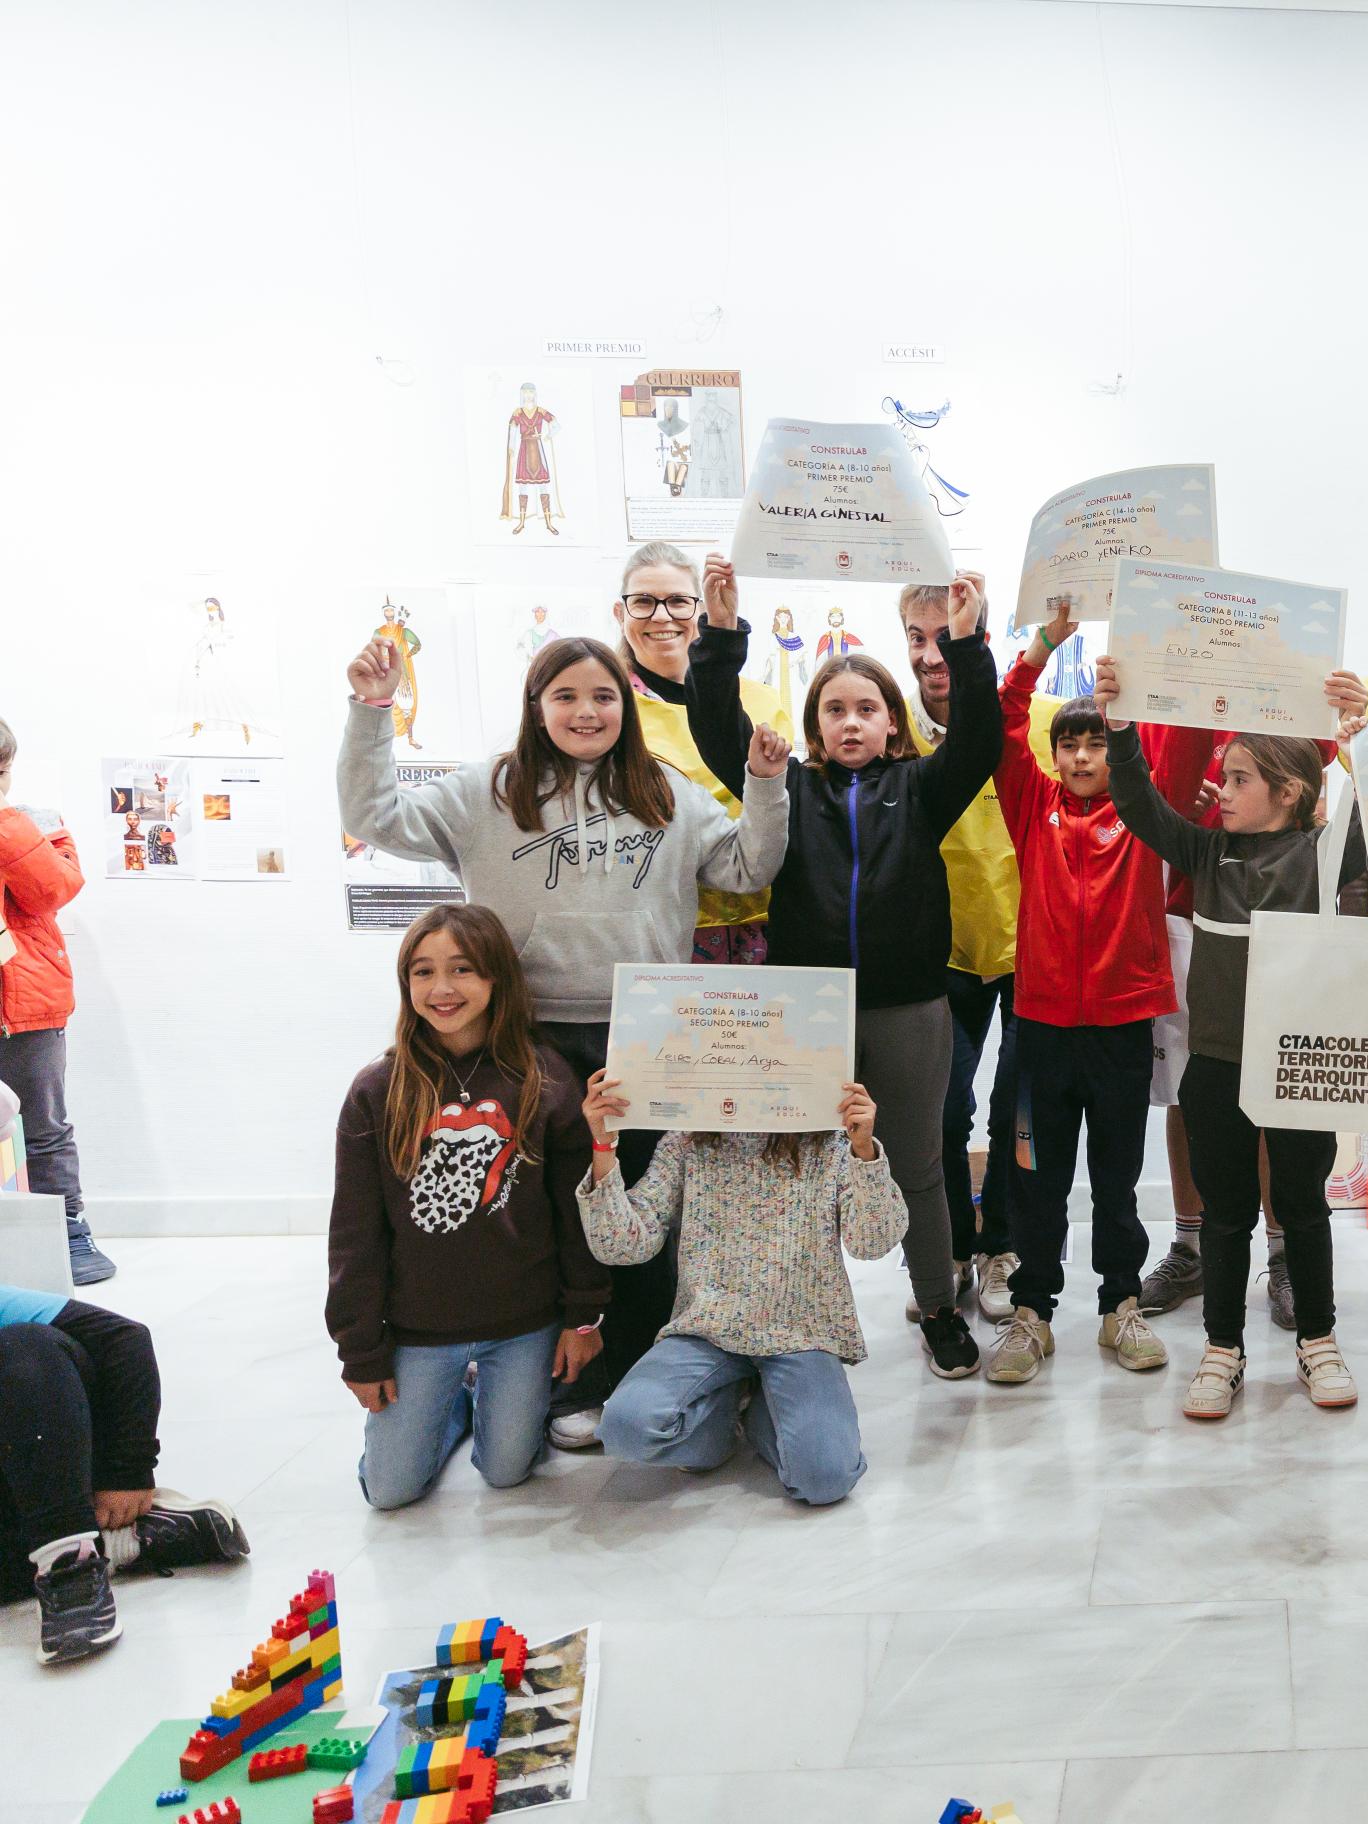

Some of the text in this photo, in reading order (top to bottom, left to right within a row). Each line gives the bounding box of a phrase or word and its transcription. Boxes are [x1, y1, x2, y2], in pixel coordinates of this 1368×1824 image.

[547, 342, 641, 353] PRIMER PREMIO
[646, 372, 735, 386] GUERRERO
[811, 445, 867, 456] CONSTRULAB
[847, 463, 869, 473] (8-10
[871, 463, 892, 473] años)
[807, 473, 874, 484] PRIMER PREMIO
[832, 485, 849, 494] 75€
[1086, 493, 1132, 507] CONSTRULAB
[758, 501, 817, 520] VALERIA
[820, 507, 892, 523] GINESTAL
[1112, 507, 1135, 516] (14-16
[1136, 505, 1156, 514] años)
[1081, 517, 1137, 530] PRIMER PREMIO
[1049, 550, 1089, 568] DARIO
[1135, 569, 1205, 583] DIPLOMA ACREDITATIVO
[1204, 591, 1257, 605] CONSTRULAB
[1190, 614, 1265, 630] SEGUNDO PREMIO
[1226, 608, 1232, 616] B
[1233, 609, 1257, 621] (11-13
[1258, 613, 1280, 624] años)
[1219, 628, 1235, 637] 50€
[1167, 643, 1214, 659] ENZO
[703, 991, 759, 1001] CONSTRULAB
[737, 1008, 760, 1018] (8-10
[761, 1008, 783, 1018] años)
[690, 1018, 770, 1028] SEGUNDO PREMIO
[721, 1030, 738, 1039] 50€
[747, 1054, 789, 1071] Arya
